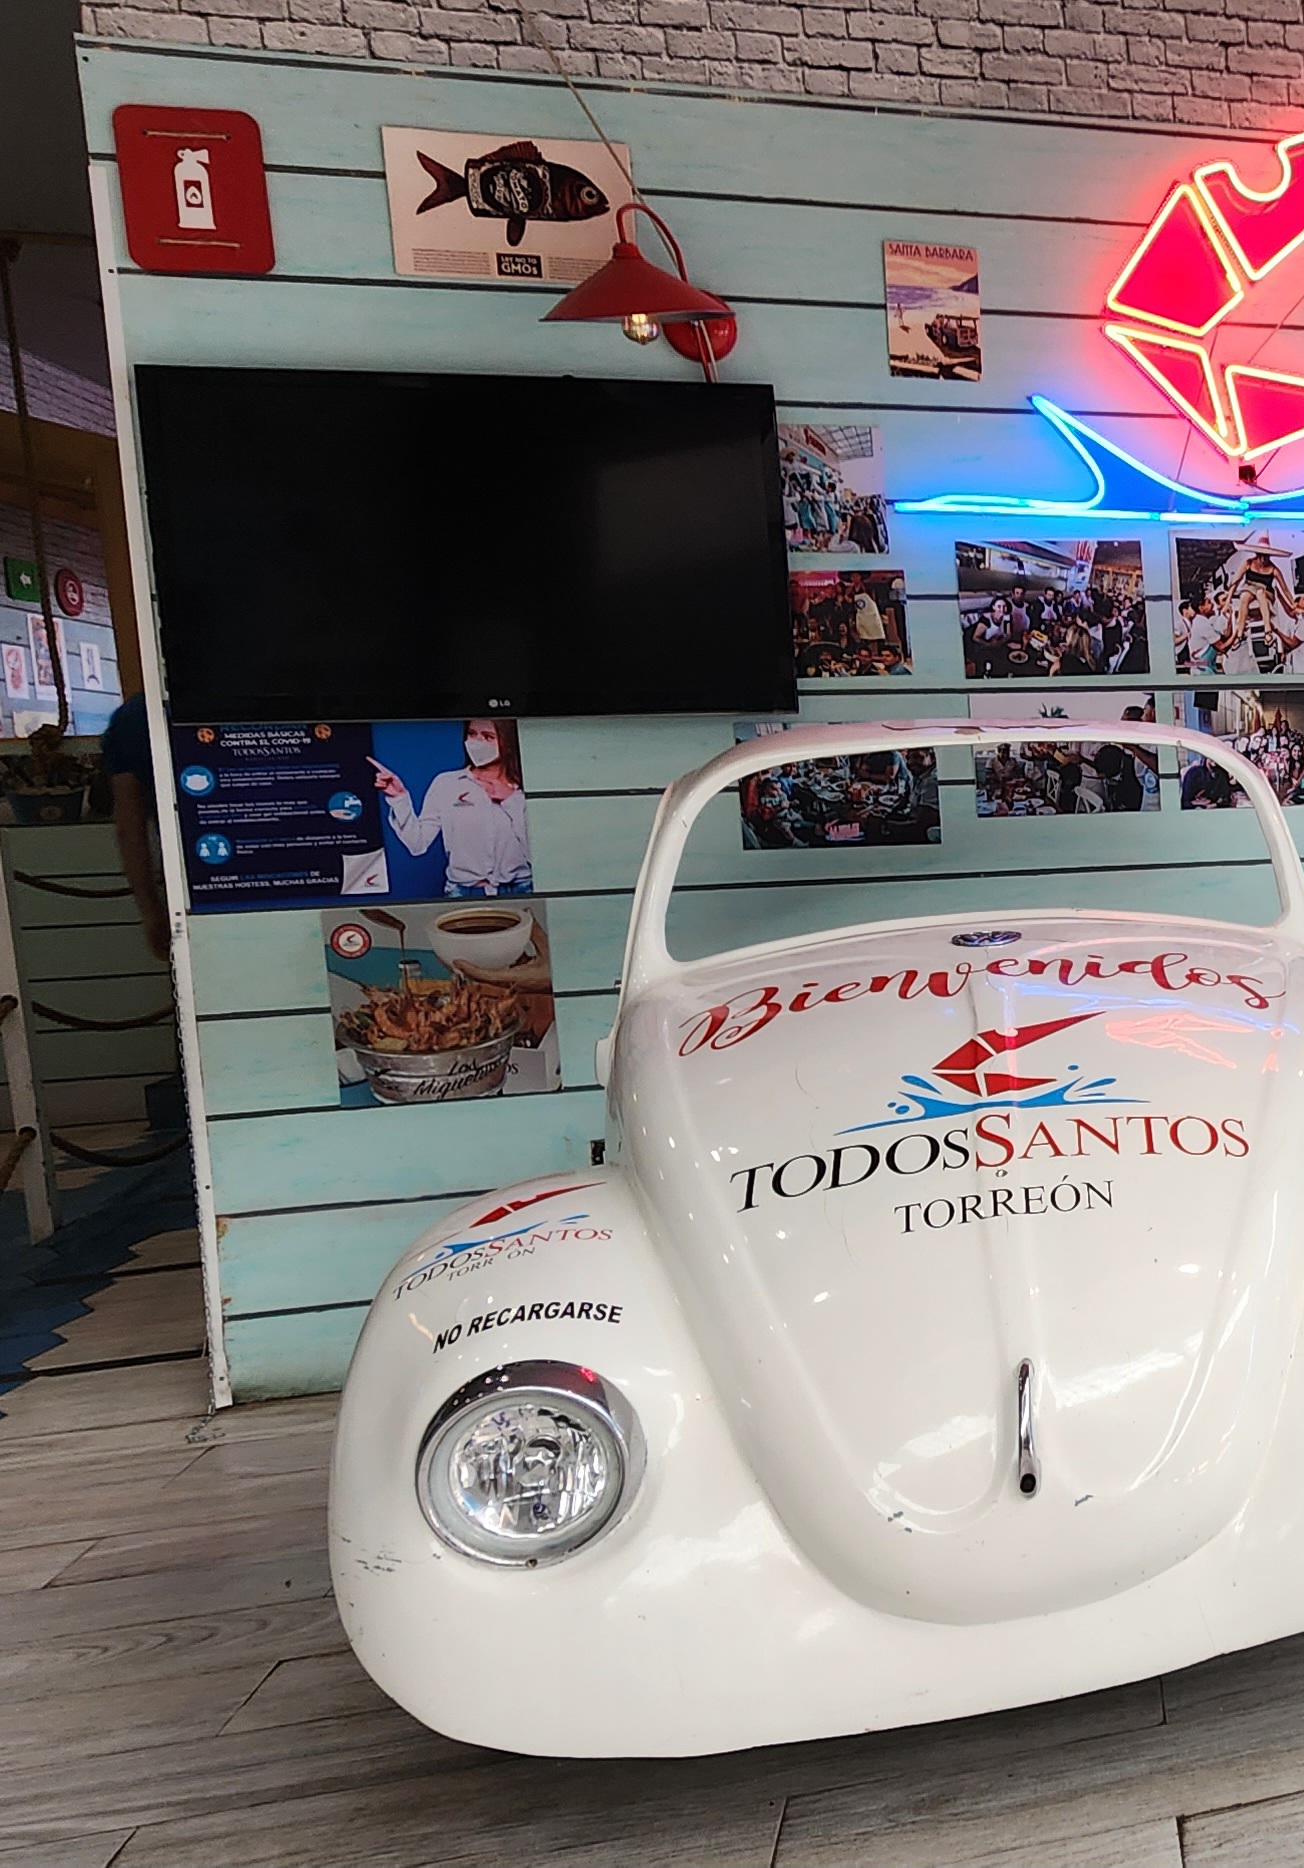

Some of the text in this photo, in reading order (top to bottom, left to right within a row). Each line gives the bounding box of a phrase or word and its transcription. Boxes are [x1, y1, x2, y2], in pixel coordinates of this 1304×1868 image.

[889, 243, 974, 261] SANTA BARBARA
[220, 739, 258, 747] CONTRA
[272, 737, 312, 745] COVID-19
[678, 952, 1287, 1057] Bienvenidos
[895, 1175, 1114, 1235] TORREÓN
[432, 1301, 623, 1355] NO RECARGARSE
